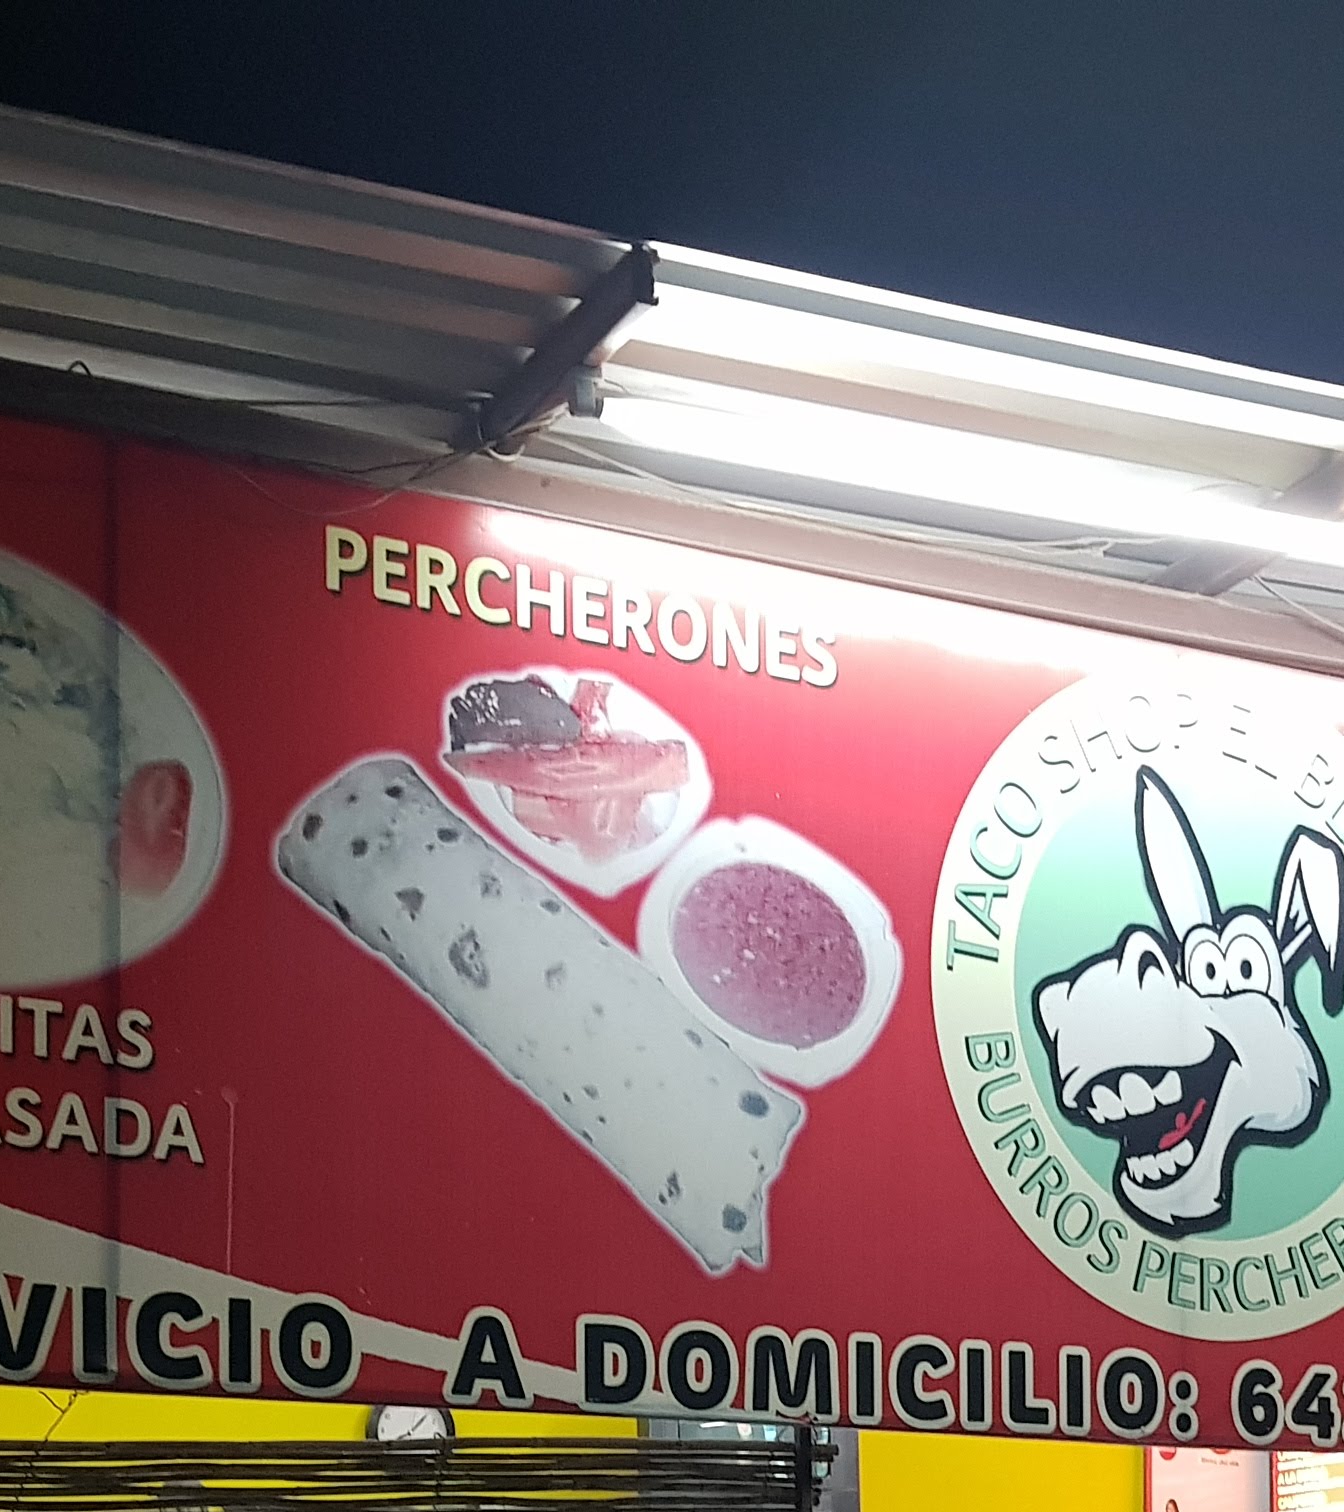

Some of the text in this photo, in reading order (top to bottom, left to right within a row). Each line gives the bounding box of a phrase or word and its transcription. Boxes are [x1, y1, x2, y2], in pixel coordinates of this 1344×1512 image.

[324, 524, 838, 689] PERCHERONES
[946, 783, 1043, 971] TACO
[965, 1031, 1128, 1274] BURROS
[445, 1305, 533, 1407] A
[575, 1314, 1198, 1441] DOMICILIO:
